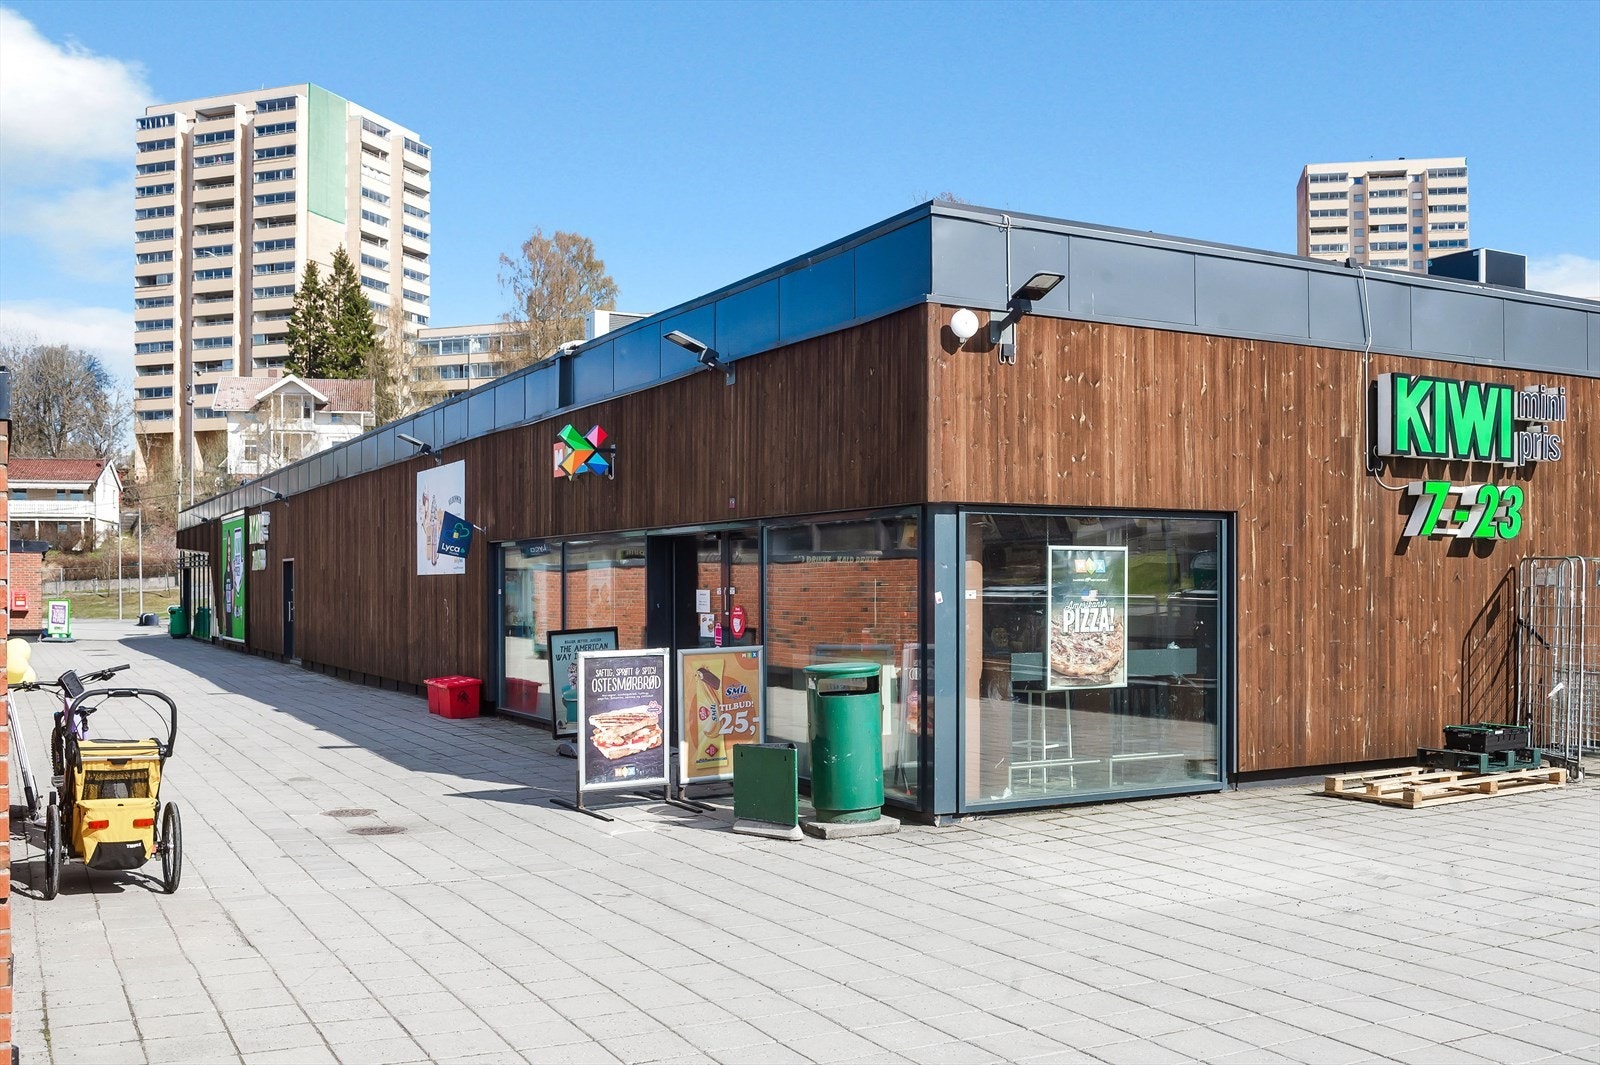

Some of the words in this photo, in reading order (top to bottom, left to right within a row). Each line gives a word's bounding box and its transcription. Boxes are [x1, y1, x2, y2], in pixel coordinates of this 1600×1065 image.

[1519, 384, 1566, 421] mini
[1392, 373, 1514, 462] KIWI
[1519, 425, 1562, 467] pris
[1419, 480, 1524, 539] 7-23
[441, 543, 460, 553] Lyca
[1063, 607, 1115, 633] PIZZA!
[555, 653, 572, 661] WAY
[560, 645, 572, 653] THE
[574, 643, 609, 653] AMERICAN
[595, 668, 615, 678] SAFTIG,
[635, 667, 640, 676] &
[642, 666, 657, 675] SPICY
[591, 675, 661, 693] OSTESMØRBRØD
[719, 700, 754, 712] TILBUD!
[718, 710, 760, 736] 25,-
